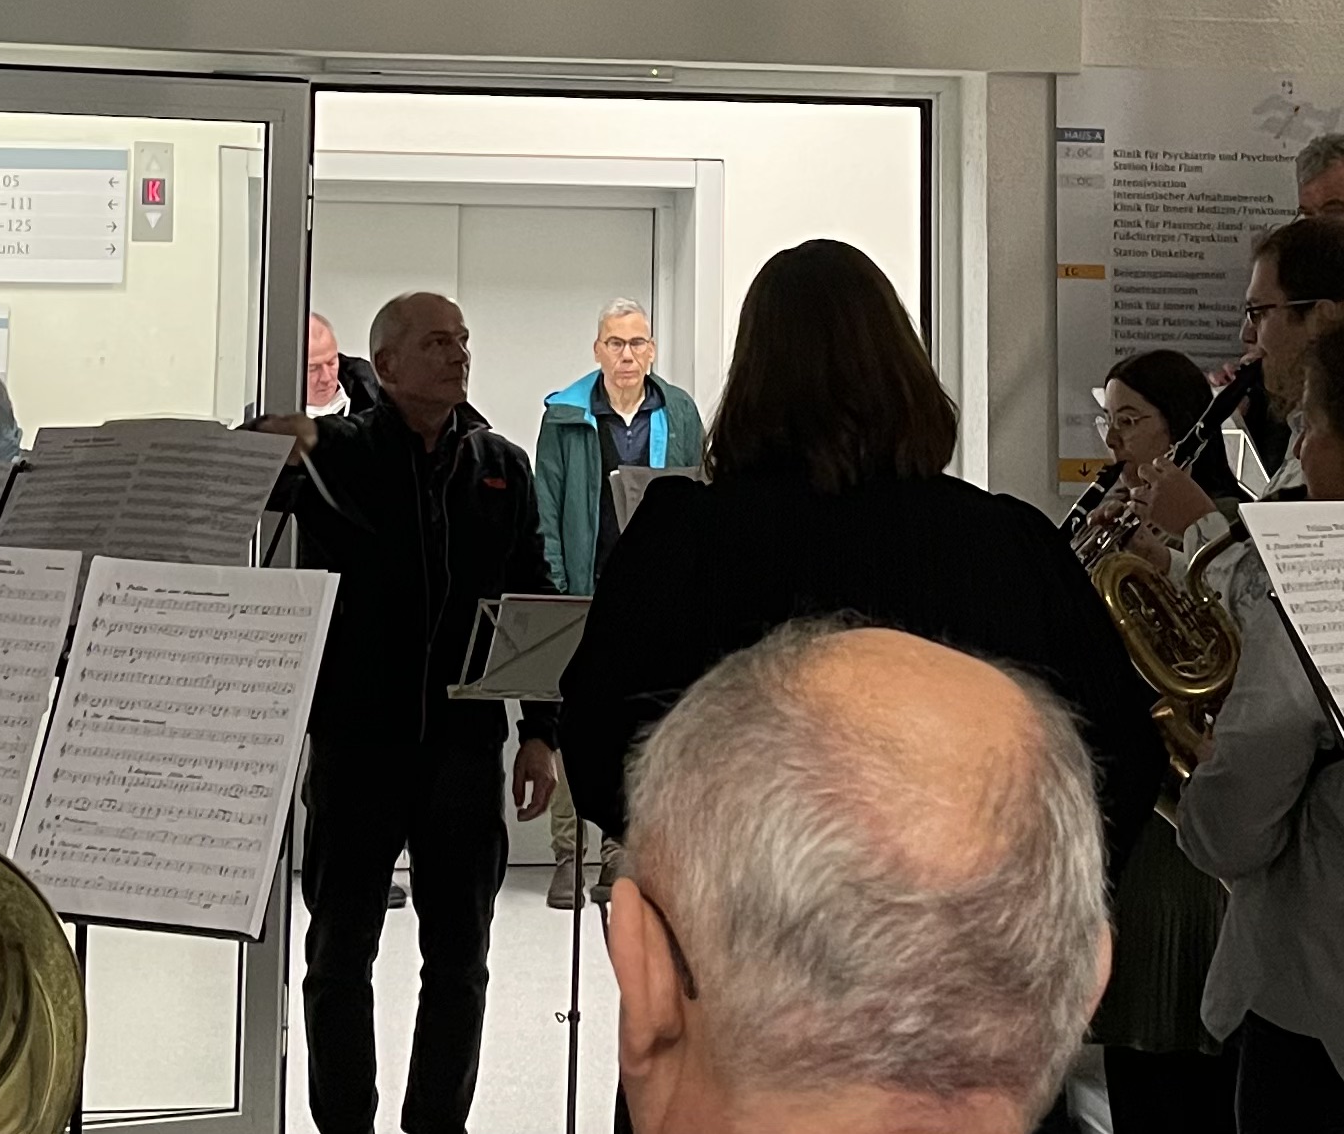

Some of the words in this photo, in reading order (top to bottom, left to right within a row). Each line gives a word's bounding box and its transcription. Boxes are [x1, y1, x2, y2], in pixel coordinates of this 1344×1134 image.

[1064, 130, 1093, 141] HAUS
[1095, 131, 1103, 141] A
[1113, 149, 1141, 159] Klinik
[1144, 149, 1159, 159] für
[1162, 150, 1216, 162] Psychiatrie
[1219, 152, 1237, 161] und
[1113, 161, 1148, 170] Station
[1113, 178, 1187, 188] Intensivstation
[148, 180, 161, 202] K
[1187, 193, 1274, 203] Aufnahmebereich
[1113, 202, 1142, 212] Klinik
[1144, 203, 1160, 213] für
[1113, 219, 1142, 229] Klinik
[1144, 220, 1160, 230] für
[1113, 247, 1149, 258] Station
[1151, 248, 1205, 260] Dinkelberg
